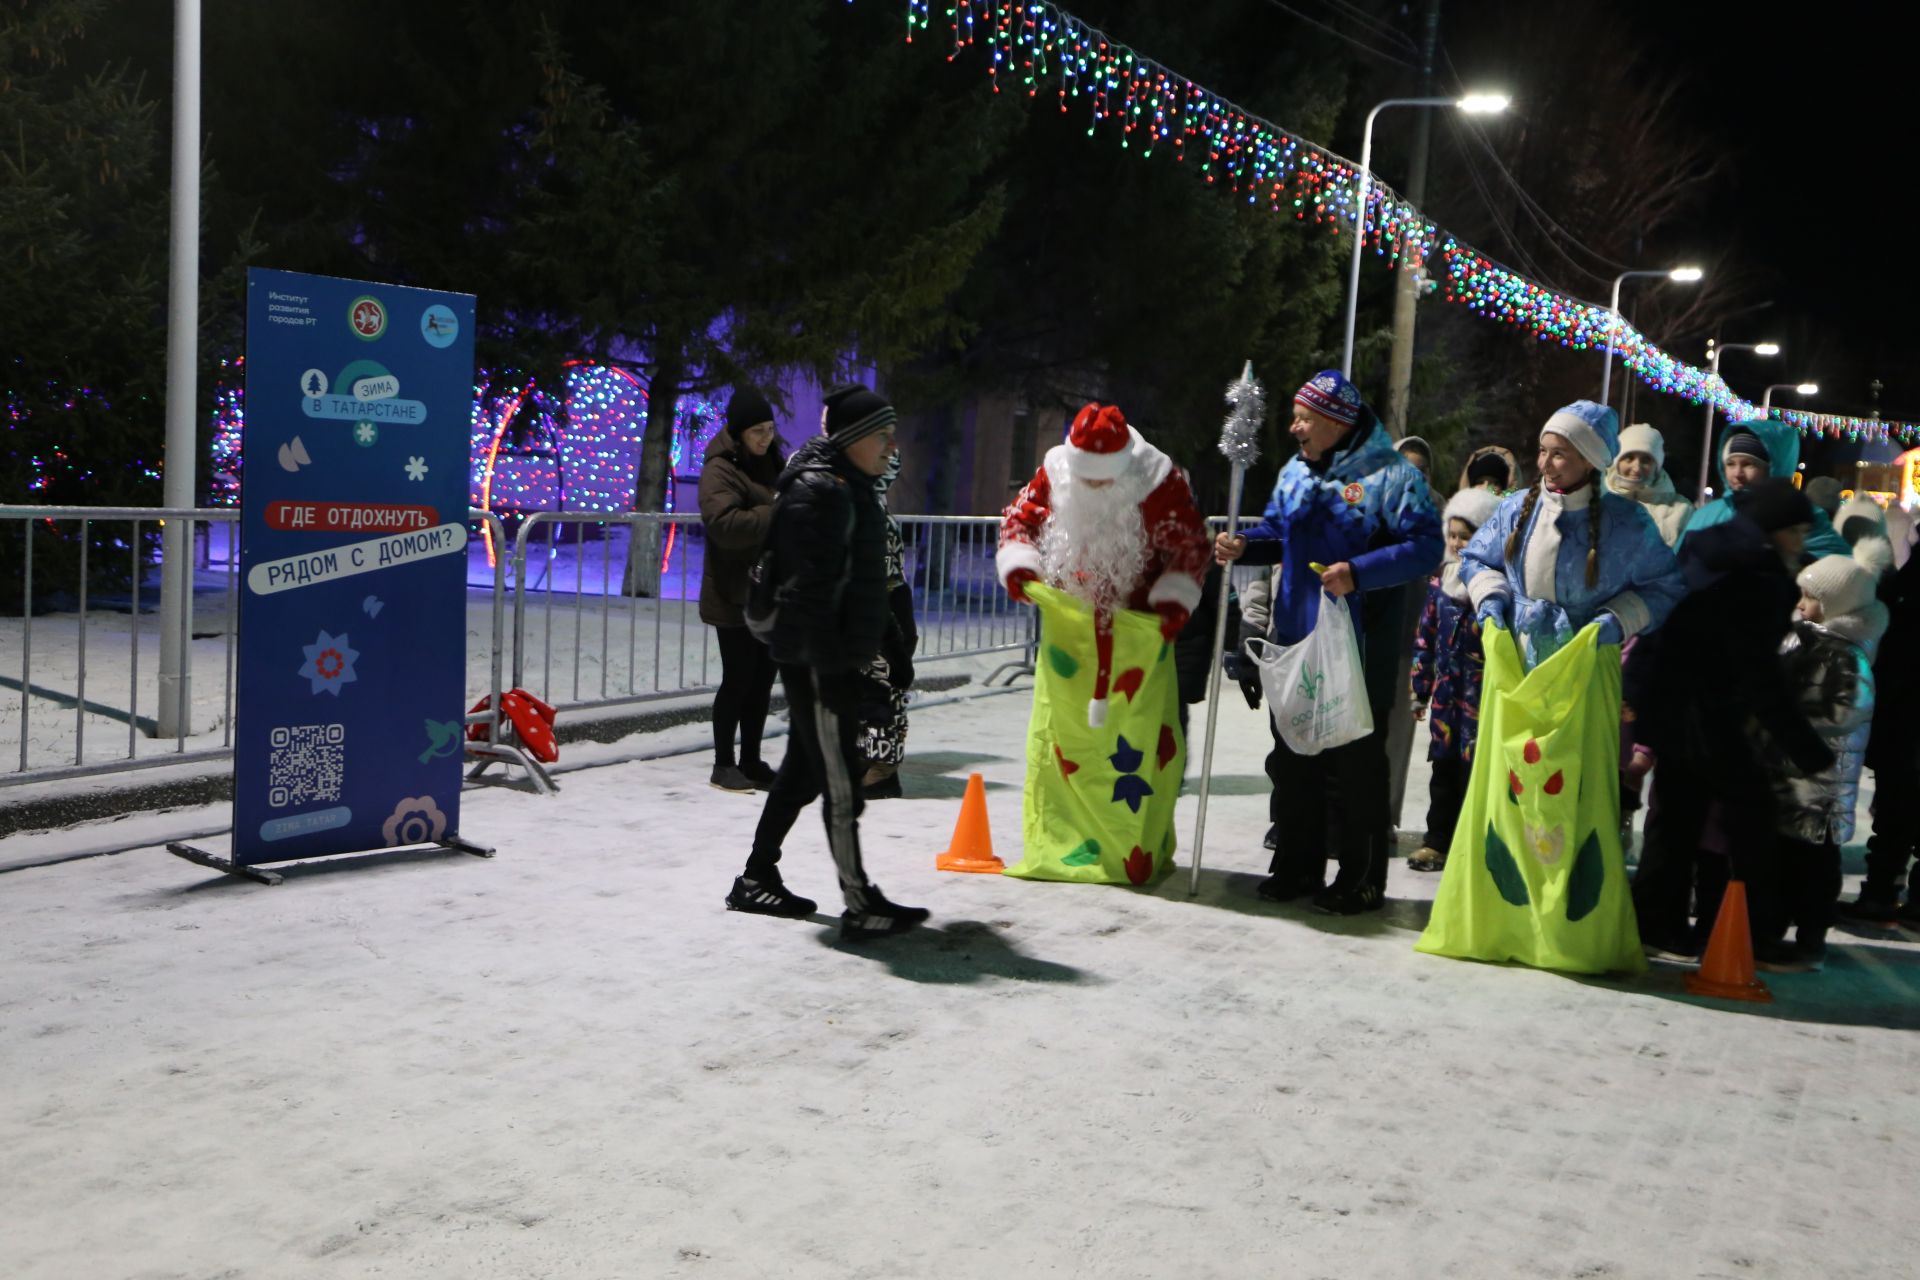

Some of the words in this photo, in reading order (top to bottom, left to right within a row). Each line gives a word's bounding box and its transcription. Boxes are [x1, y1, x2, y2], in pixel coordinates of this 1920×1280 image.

[269, 291, 309, 304] Институт
[269, 304, 310, 314] развития
[269, 315, 304, 325] городов
[305, 317, 318, 326] РТ
[361, 381, 393, 397] ЗИМА
[313, 400, 322, 412] В
[331, 400, 417, 419] ТАТАРСТАНЕ
[280, 506, 316, 527] ГДЕ
[327, 508, 429, 529] ОТДОХНУТЬ
[267, 552, 338, 586] РЯДОМ
[351, 547, 364, 567] С
[379, 528, 453, 565] ДОМОМ?
